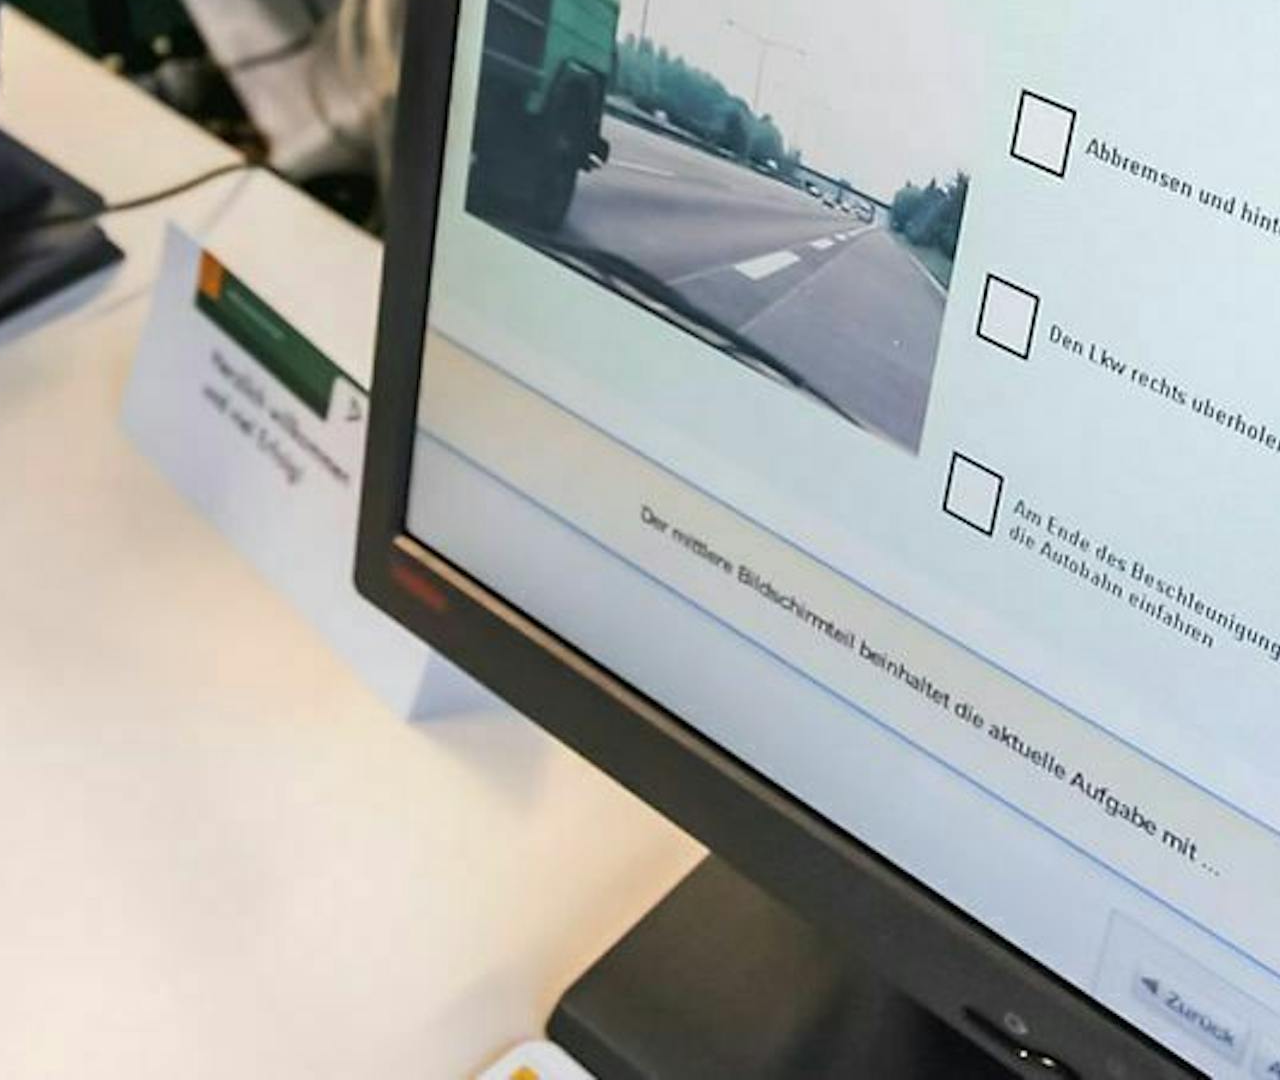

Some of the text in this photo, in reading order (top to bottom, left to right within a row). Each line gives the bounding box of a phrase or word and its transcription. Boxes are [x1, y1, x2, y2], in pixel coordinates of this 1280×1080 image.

[1085, 137, 1193, 198] Abbremsen
[1199, 187, 1236, 215] und
[1049, 324, 1083, 354] Den
[1088, 344, 1126, 376] Lkw
[1131, 368, 1187, 405] rechts
[1013, 499, 1042, 526] Am
[1047, 515, 1090, 552] Ende
[1096, 545, 1126, 572] des
[1009, 525, 1214, 649] die Autobahn einfahren
[640, 504, 670, 534] Der
[737, 564, 856, 650] Bildschirmteil
[859, 640, 951, 710] beinhaltet
[954, 700, 985, 729] die
[988, 725, 1066, 781] aktuelle
[1070, 771, 1158, 837] Aufgabe
[1162, 827, 1198, 862] mit
